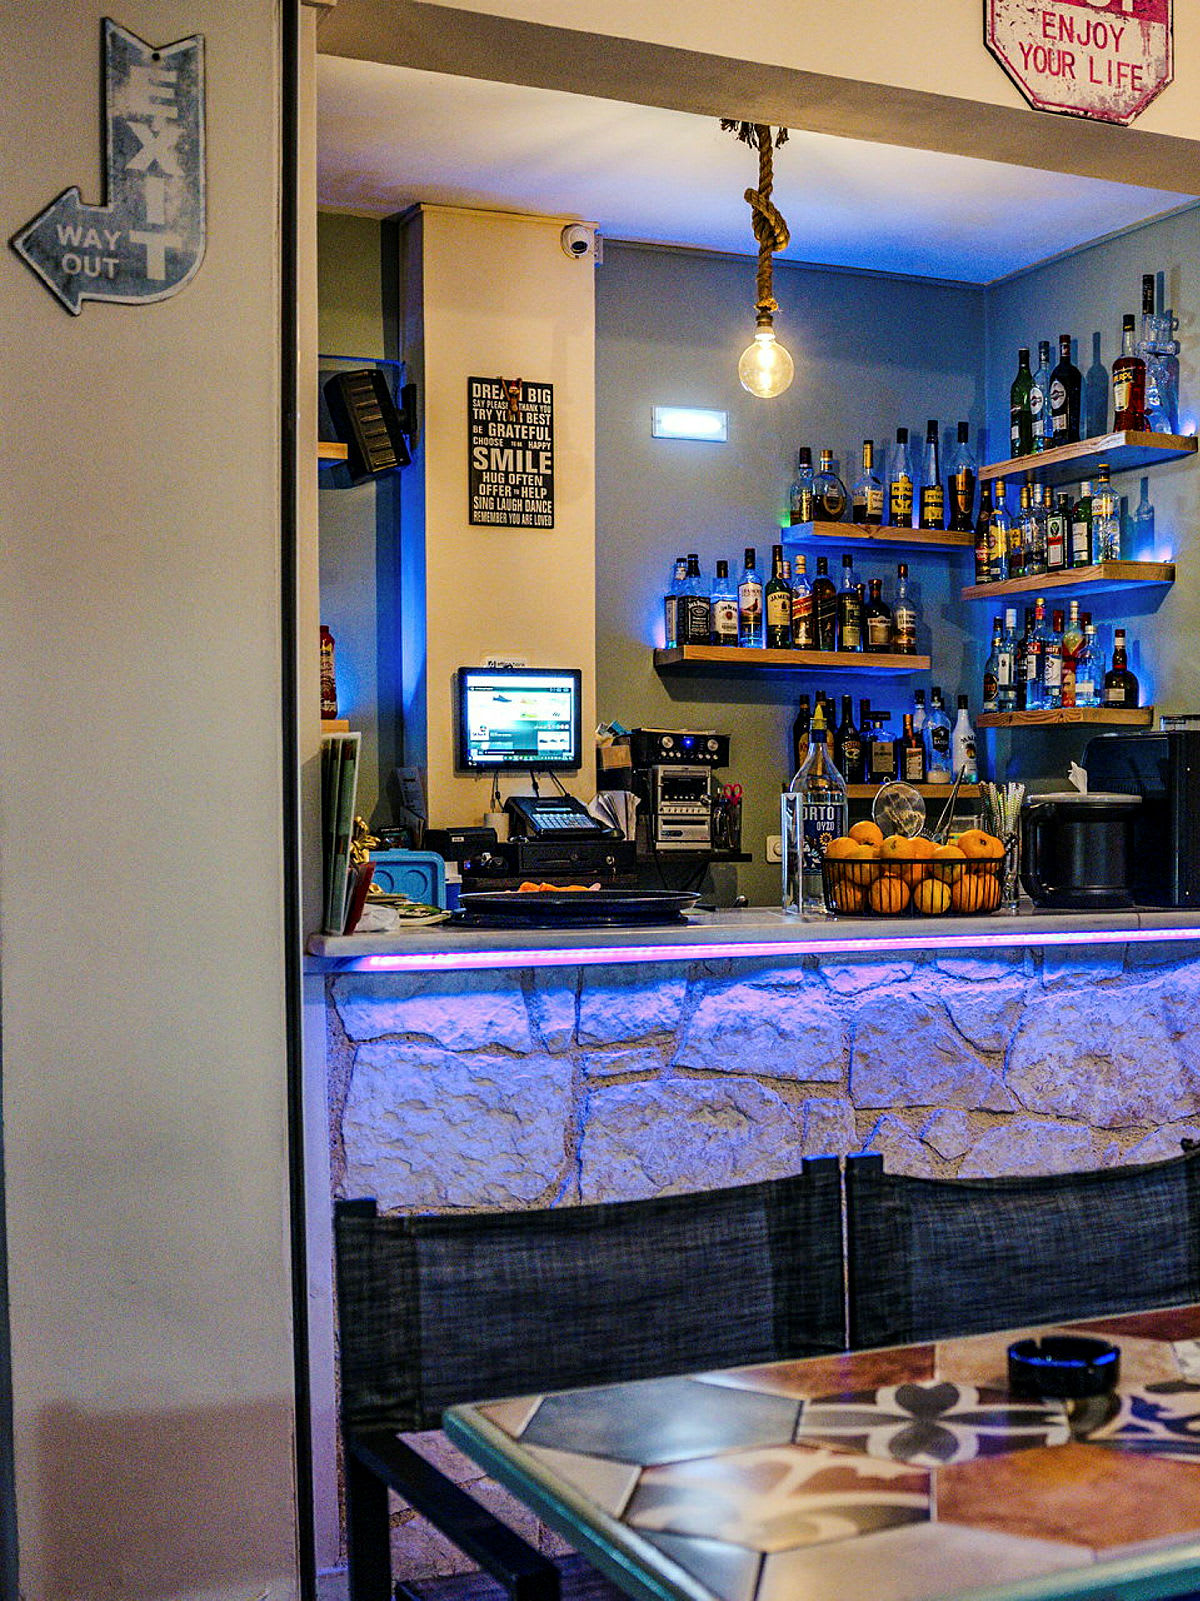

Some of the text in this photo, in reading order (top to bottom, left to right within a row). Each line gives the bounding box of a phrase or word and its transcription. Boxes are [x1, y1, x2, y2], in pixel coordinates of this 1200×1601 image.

[1042, 10, 1125, 53] ENJOY
[1018, 41, 1144, 92] YOUR LIFE
[126, 64, 186, 281] EXIT
[56, 223, 122, 251] WAY
[61, 253, 120, 280] OUT
[527, 387, 551, 404] BIG
[472, 399, 485, 408] SAY
[486, 400, 509, 410] PLEASE
[518, 403, 539, 412] THANK
[472, 408, 492, 421] TRY
[526, 412, 551, 426] BEST
[472, 422, 551, 441] BE GRATEFUL
[472, 437, 504, 447] CHOOSE
[528, 441, 551, 450] HAPPY
[473, 446, 552, 474] SMILE
[482, 472, 543, 487] HUG OFTEN
[478, 484, 512, 497] OFFER
[521, 486, 547, 499] HELP
[473, 496, 552, 514] SING LAUGH DANCE
[473, 510, 552, 527] REMEMBER YOU ARE LOVED
